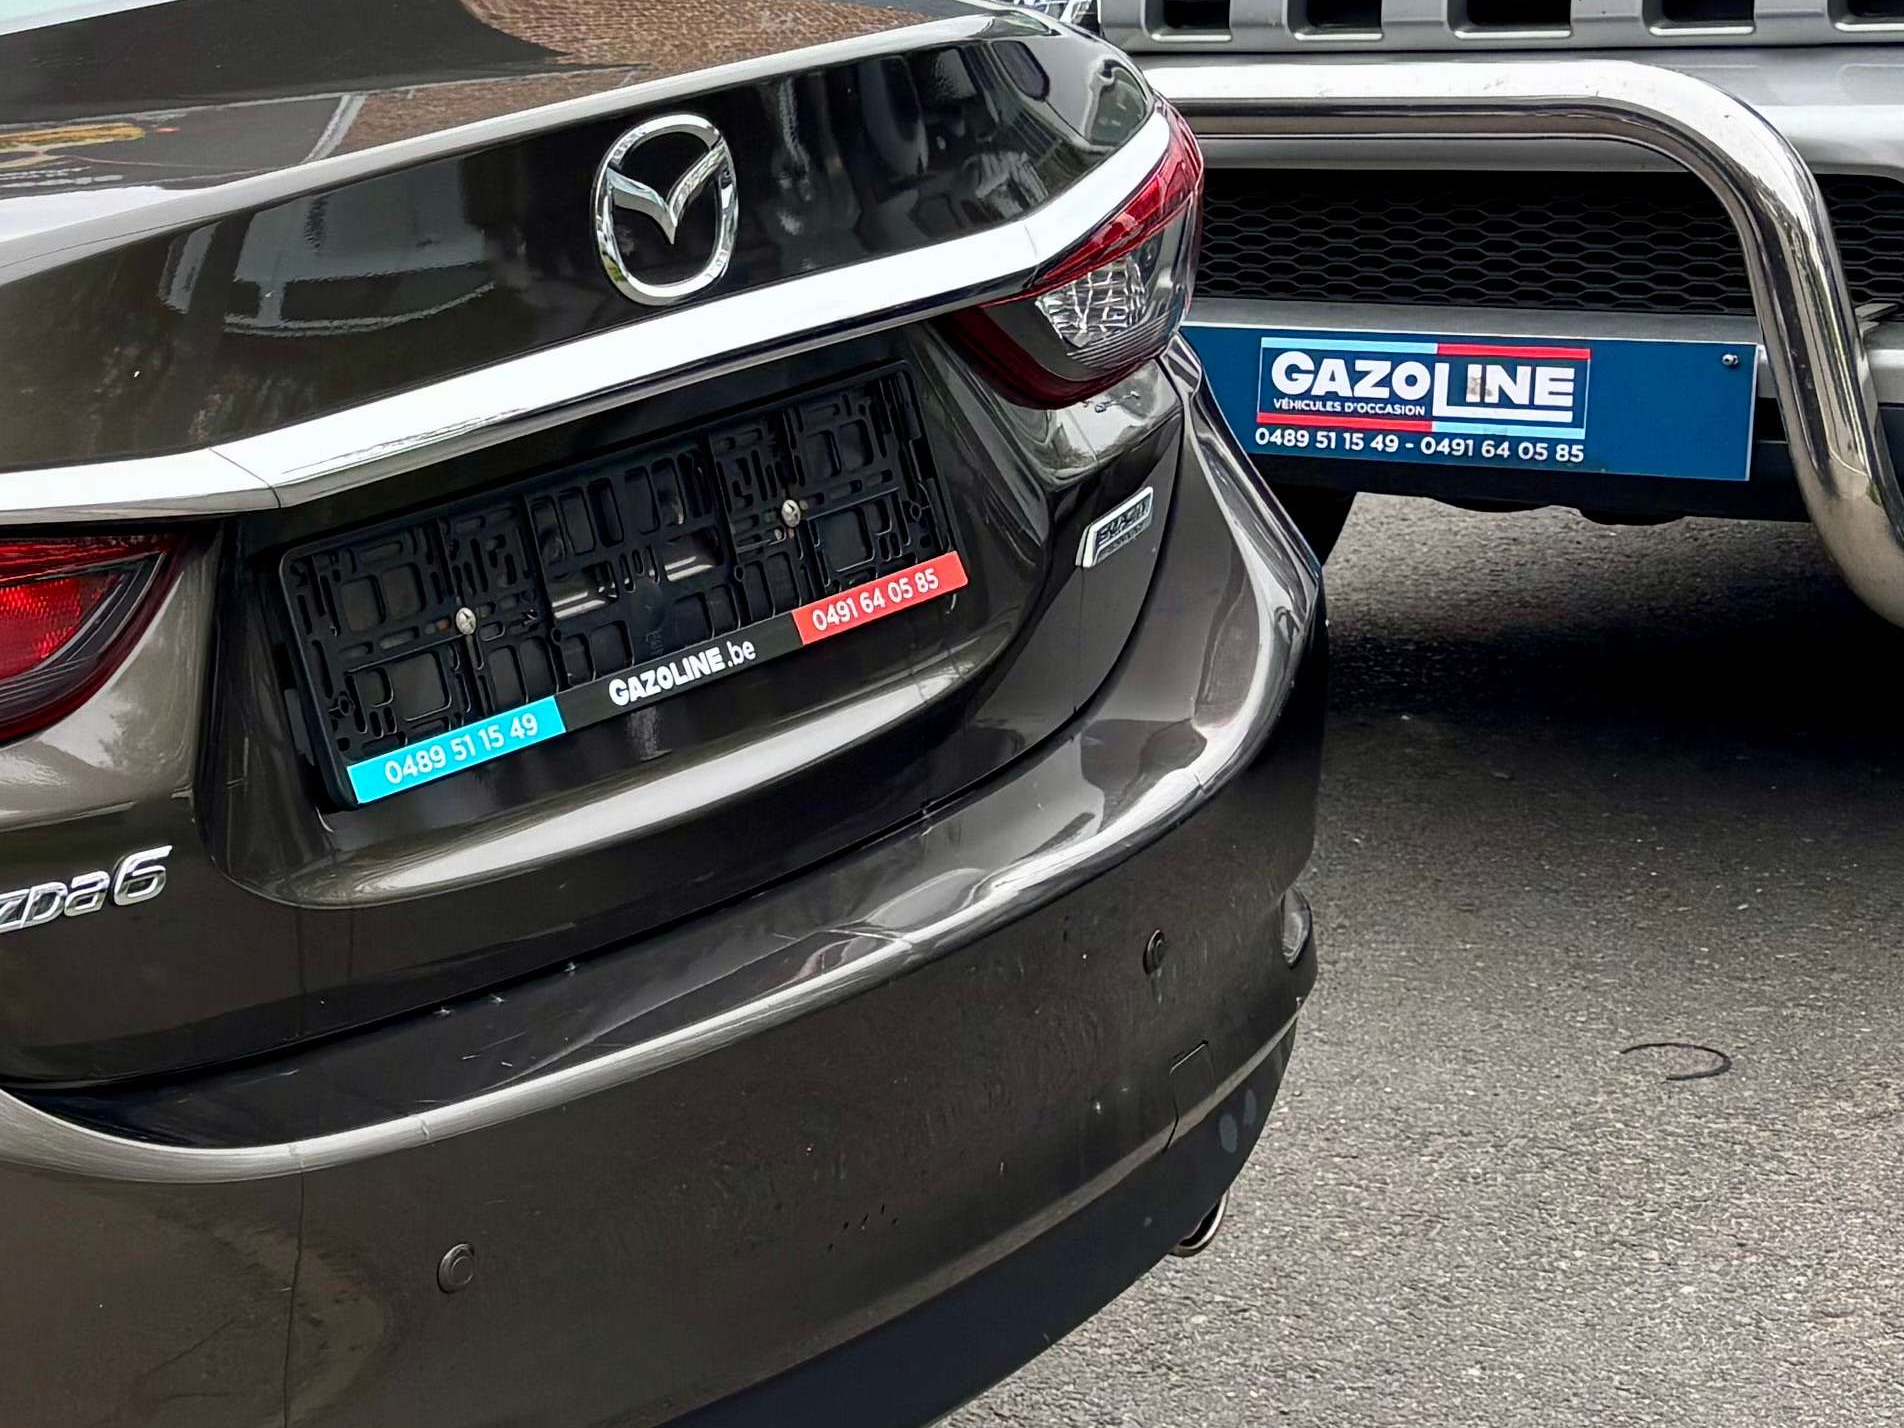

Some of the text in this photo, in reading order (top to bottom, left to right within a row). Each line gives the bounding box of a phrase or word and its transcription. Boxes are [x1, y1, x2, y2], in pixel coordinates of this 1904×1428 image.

[1271, 350, 1576, 423] GAZOLINE
[1273, 397, 1426, 416] VÉHICULES D'OCCASION
[1255, 427, 1310, 446] 0489
[1315, 431, 1337, 449] 51
[1343, 432, 1365, 451] 15
[1370, 434, 1399, 453] 49
[1420, 436, 1474, 457] 0491
[1481, 440, 1511, 459] 64
[1518, 442, 1548, 461] 05
[1555, 444, 1584, 463] 85
[812, 567, 940, 631] 0491 64 05 85
[384, 712, 539, 784] 0489 51 15 49
